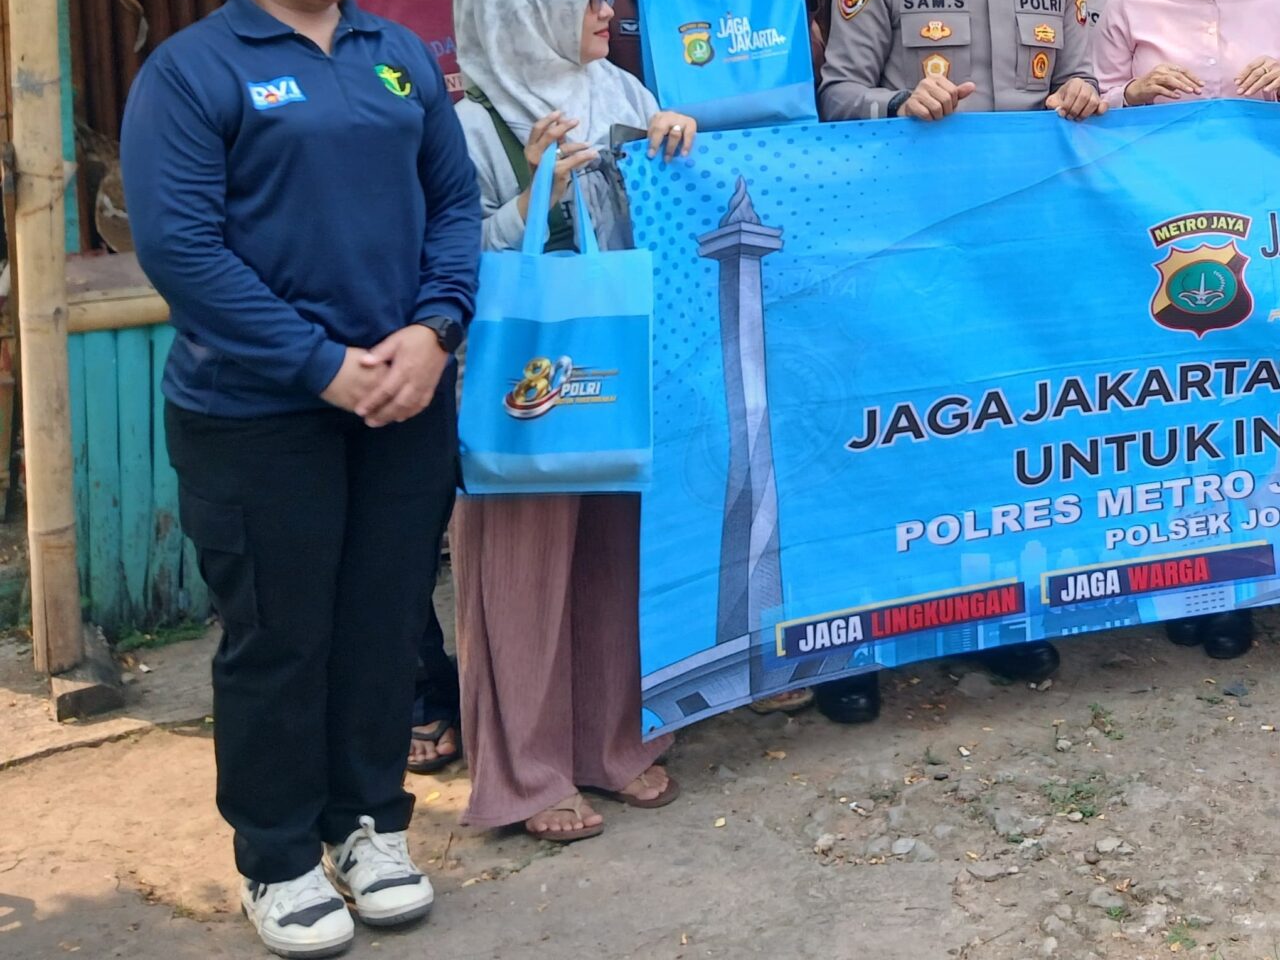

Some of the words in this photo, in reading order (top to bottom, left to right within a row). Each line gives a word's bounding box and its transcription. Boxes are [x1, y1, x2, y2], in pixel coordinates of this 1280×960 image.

[717, 15, 751, 39] JAGA
[1153, 216, 1208, 242] METRO
[1211, 216, 1245, 233] JAYA
[560, 381, 602, 397] POLRI
[846, 389, 1016, 452] JAGA
[1014, 421, 1224, 486] UNTUK
[895, 493, 1082, 553] POLRES
[1097, 470, 1256, 519] METRO
[1105, 510, 1232, 551] POLSEK
[1060, 569, 1121, 603] JAGA
[1127, 557, 1210, 591] WARGA
[799, 615, 863, 652] JAGA
[871, 586, 1018, 638] LINGKUNGAN
